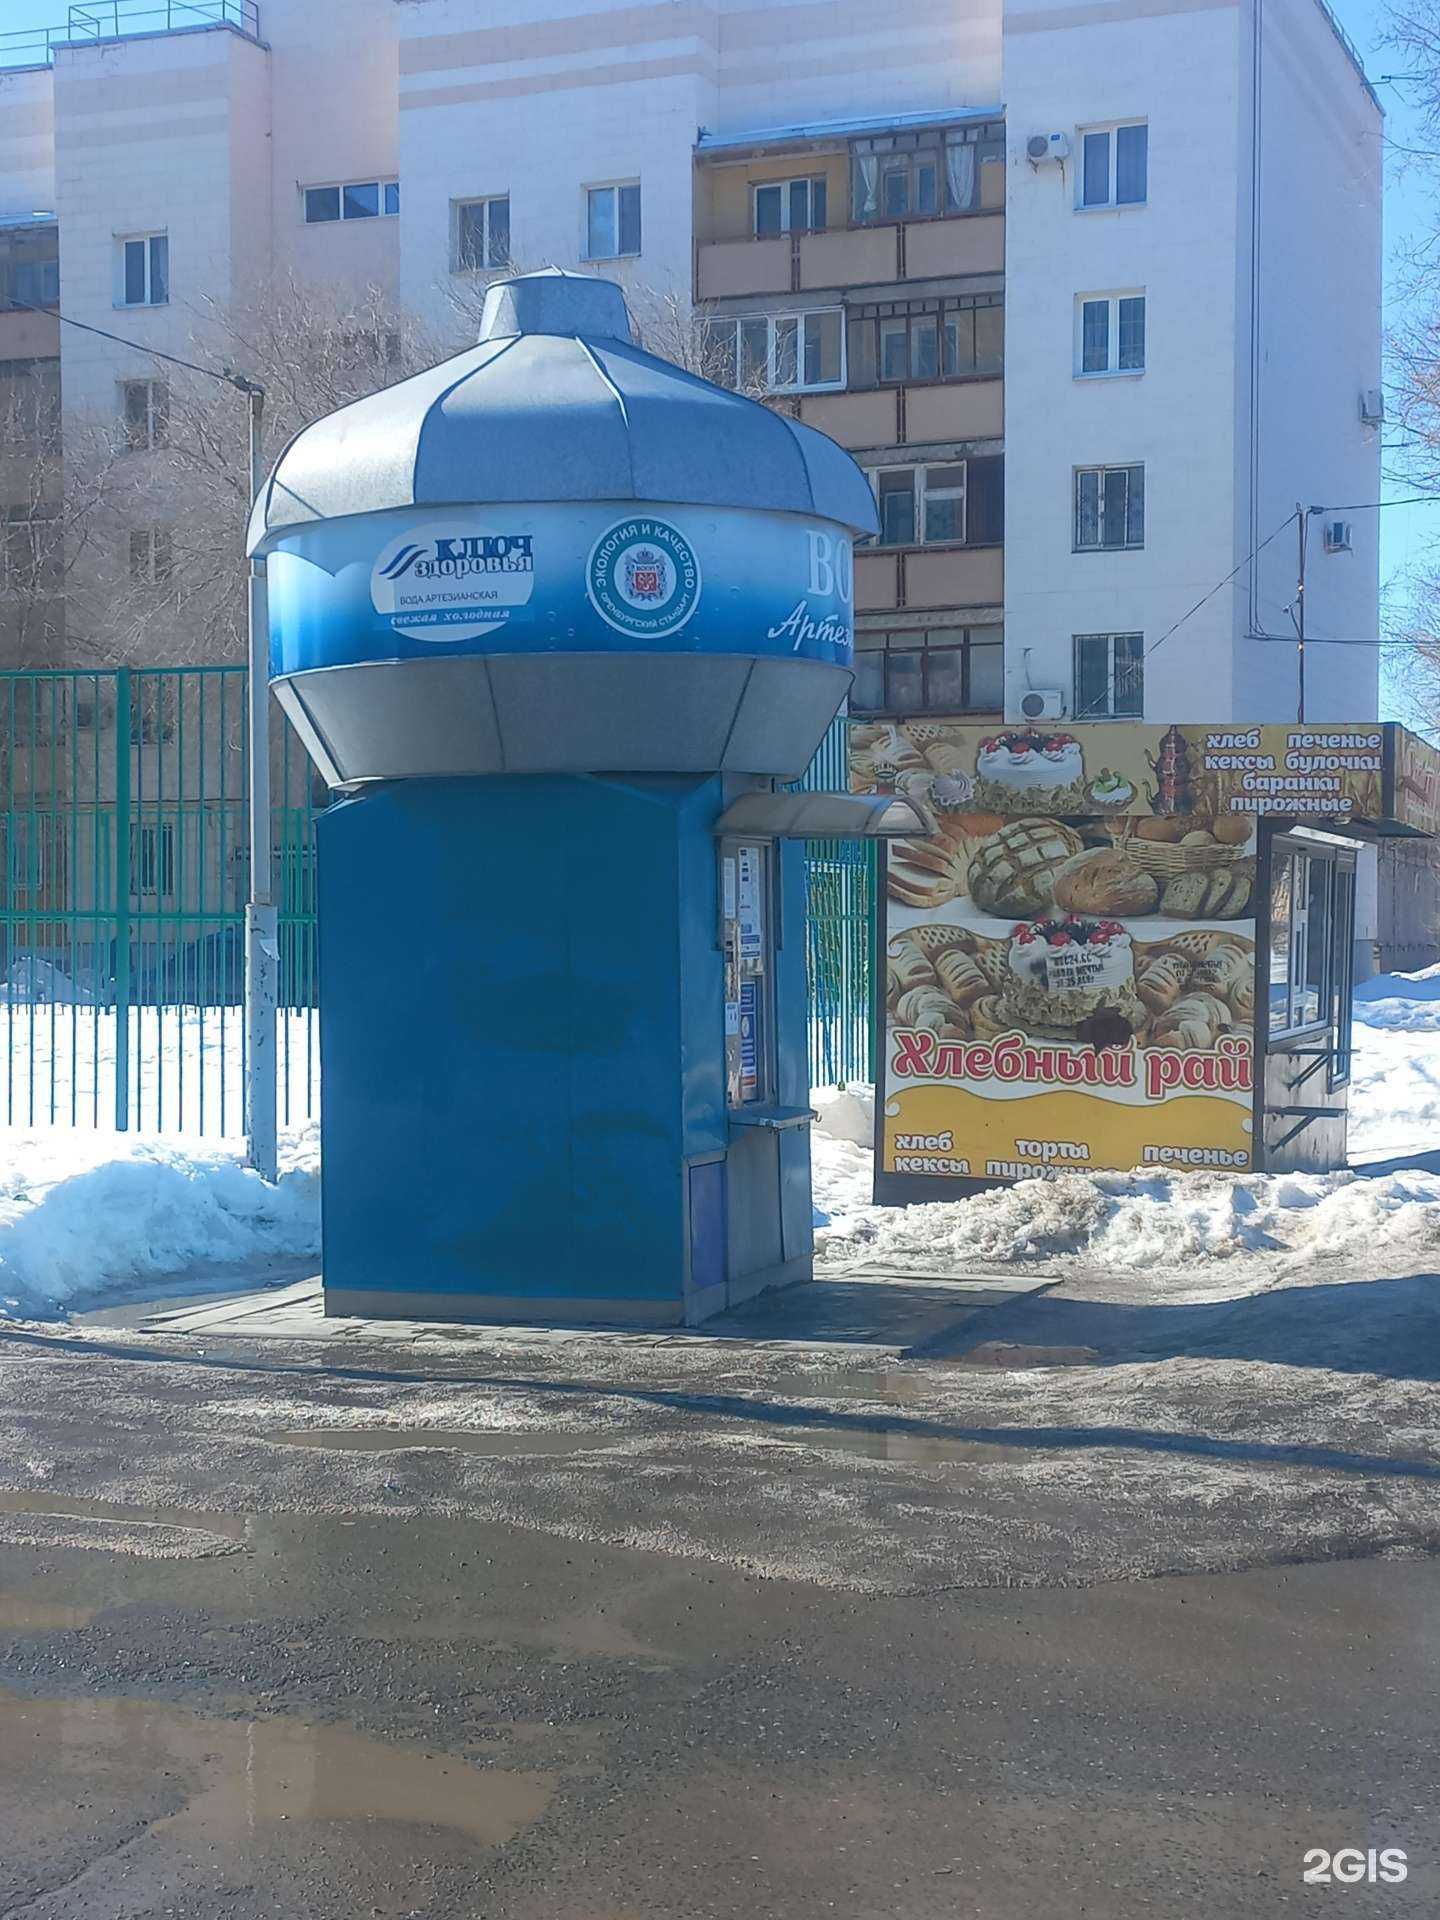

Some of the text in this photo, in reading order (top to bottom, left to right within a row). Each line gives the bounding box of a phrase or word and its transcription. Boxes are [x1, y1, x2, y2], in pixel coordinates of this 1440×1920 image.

[595, 523, 695, 589] ЭКОЛОГИЯ И КАЧЕСТВО
[400, 589, 498, 606] ВОДА АРТЕЗИАНСКАЯ
[391, 607, 511, 626] свежая холодная
[601, 592, 691, 629] ОРЕНБУРГСКИЙ СТАНДАРТ
[768, 600, 853, 651] Артез
[1206, 728, 1382, 750] хлеб печенье
[1205, 751, 1382, 774] кексы булочки
[1242, 772, 1342, 796] баранки
[1230, 795, 1353, 817] пирожные
[894, 1032, 1251, 1096] Хлебный рай
[895, 1130, 953, 1151] хлеб
[1015, 1139, 1089, 1163] торты
[894, 1155, 970, 1175] кексы
[1143, 1145, 1249, 1167] печенье
